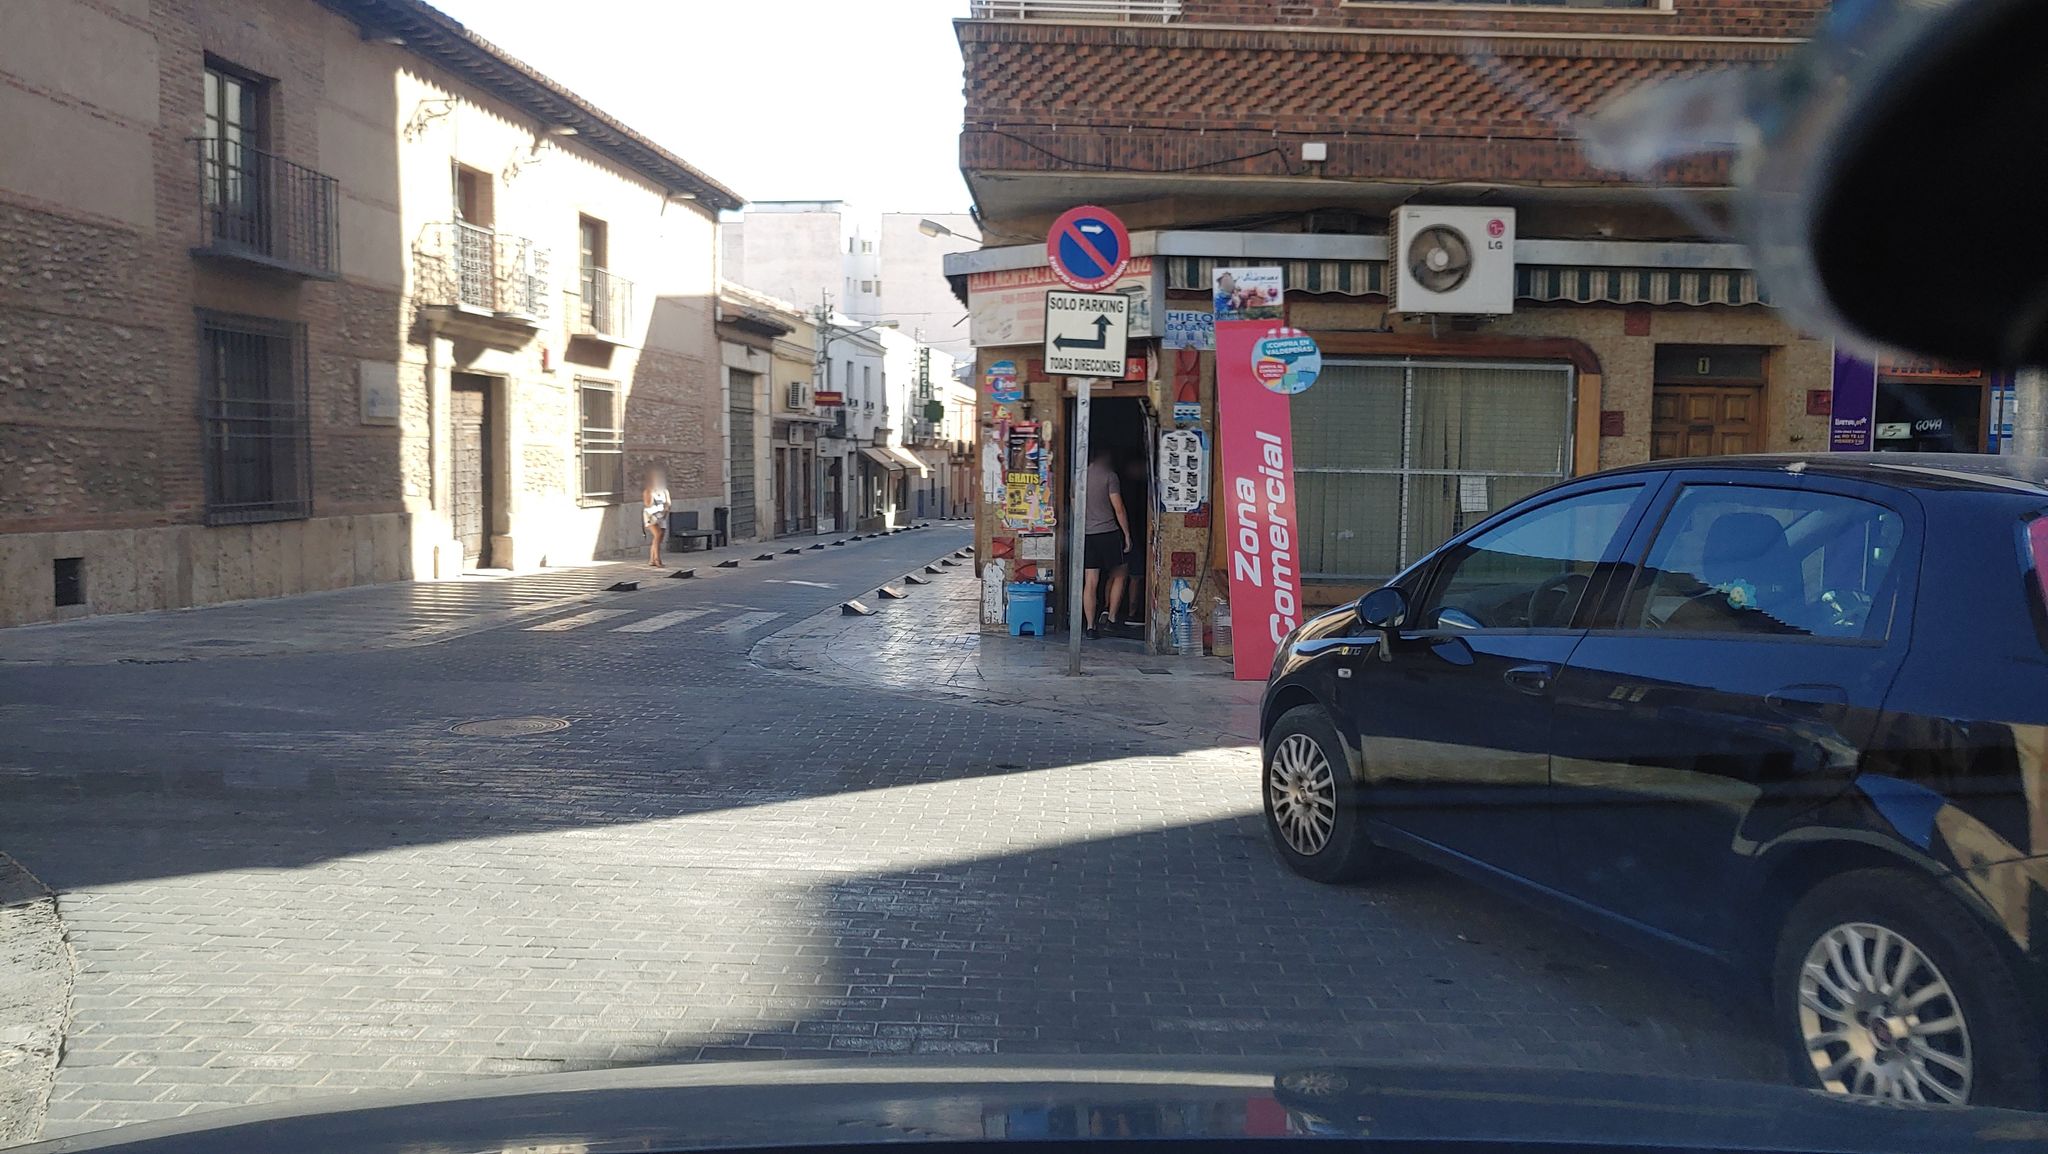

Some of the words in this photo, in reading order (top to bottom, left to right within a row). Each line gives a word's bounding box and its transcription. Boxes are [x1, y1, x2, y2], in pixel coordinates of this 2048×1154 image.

[1488, 241, 1503, 250] LG
[1050, 297, 1077, 310] SOLO
[1080, 299, 1124, 313] PARKING
[1168, 313, 1213, 322] HIELO
[1049, 357, 1073, 370] TODAS
[1074, 358, 1120, 373] DIRECCIONES
[1915, 419, 1943, 431] GOYA
[1008, 472, 1039, 484] GRATIS
[1234, 476, 1263, 587] Zona
[1256, 430, 1297, 645] Comercial
